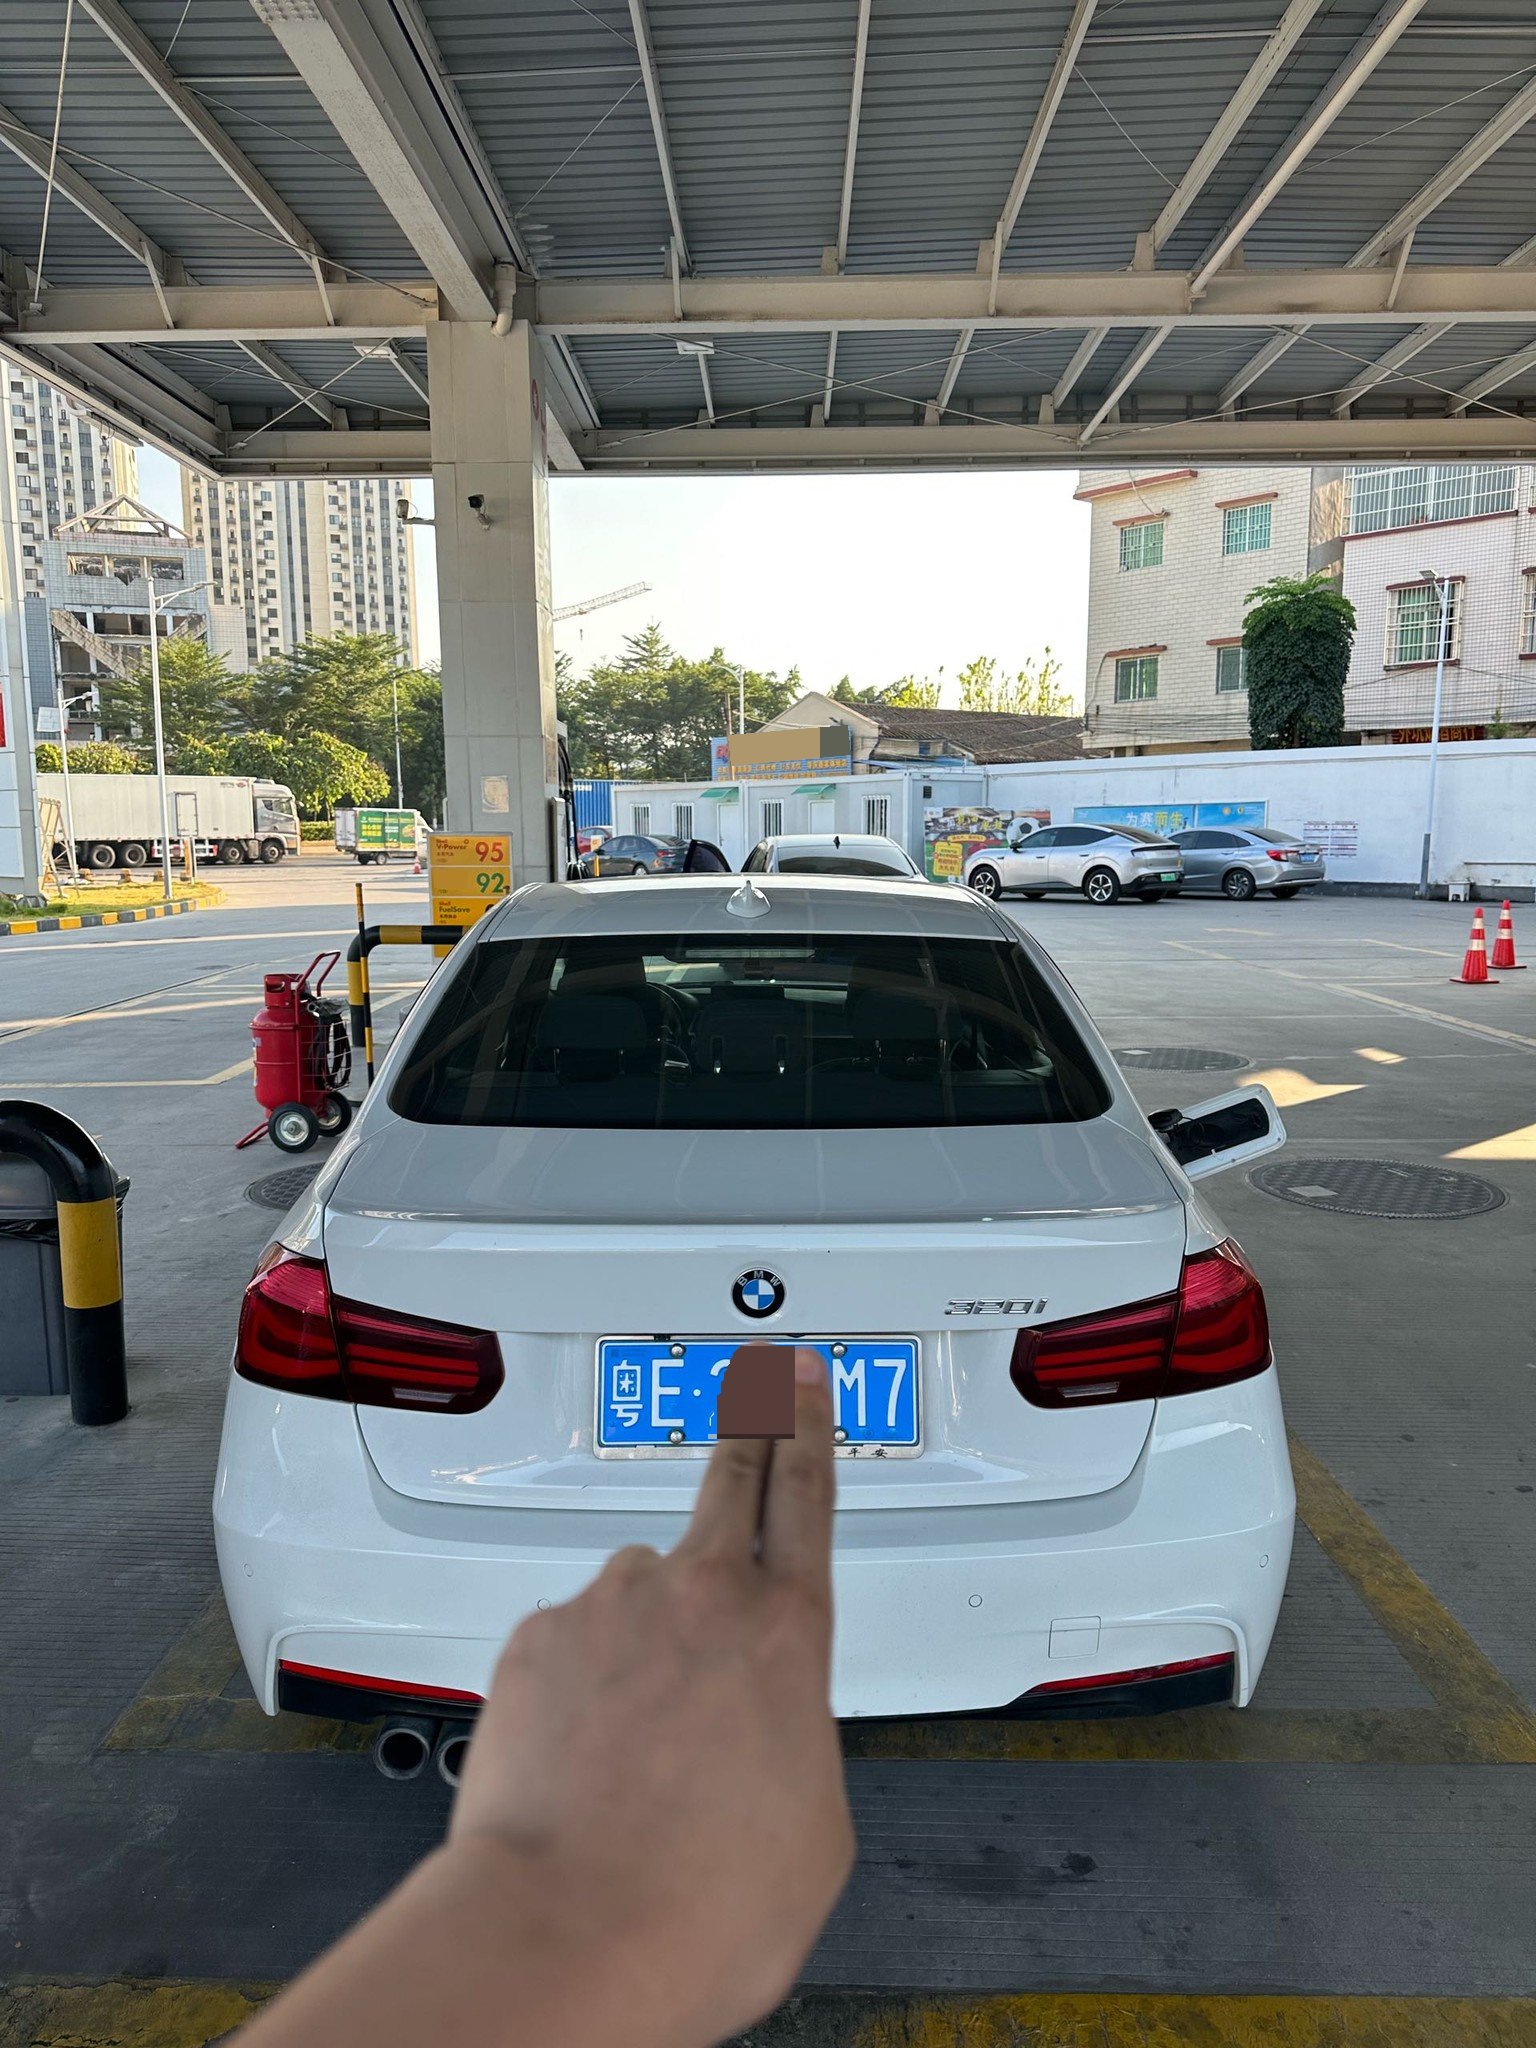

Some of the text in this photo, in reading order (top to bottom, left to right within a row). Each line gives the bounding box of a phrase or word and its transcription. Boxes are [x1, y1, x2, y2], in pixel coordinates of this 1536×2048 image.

[475, 841, 504, 862] 95
[476, 872, 504, 893] 92
[439, 905, 470, 913] FuelSave
[737, 1270, 781, 1287] BMW
[944, 1298, 1049, 1315] 320i
[609, 1358, 907, 1428] 粤E·M7
